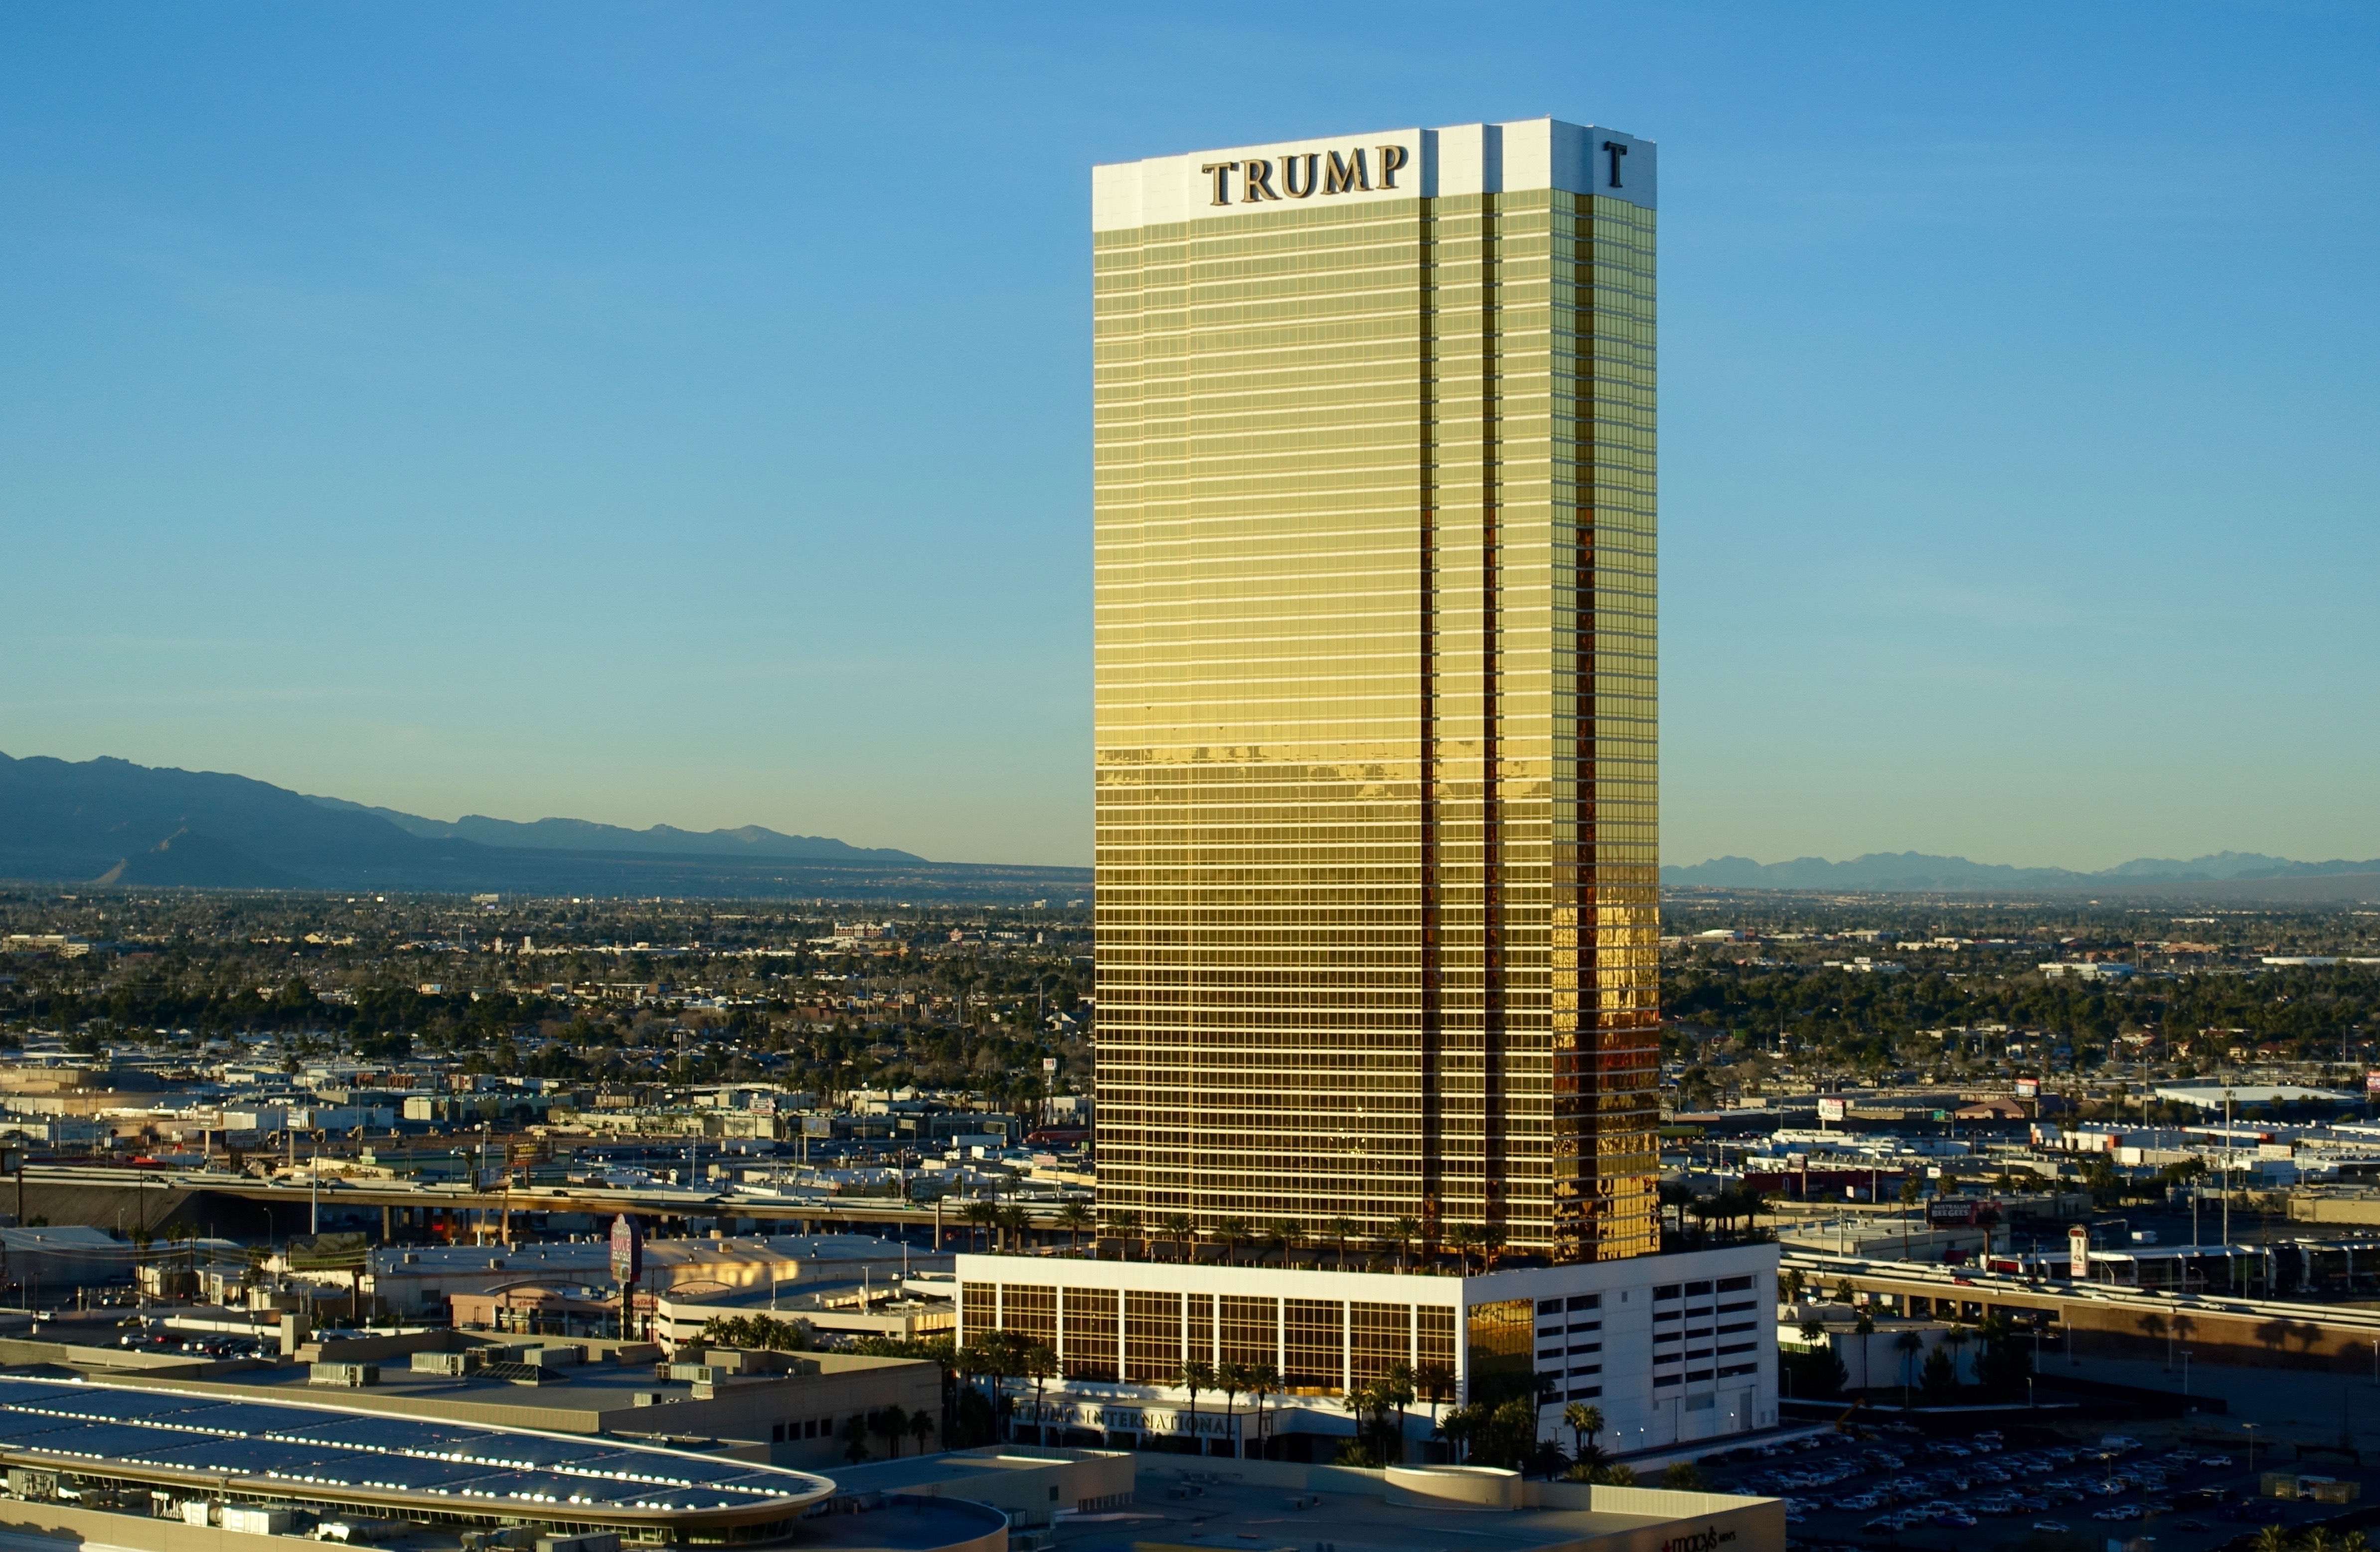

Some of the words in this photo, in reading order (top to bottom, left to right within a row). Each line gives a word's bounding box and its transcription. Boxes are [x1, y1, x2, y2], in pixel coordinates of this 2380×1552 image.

[1201, 144, 1409, 207] TRUMP
[1603, 140, 1628, 188] T
[612, 1234, 630, 1251] LOVE
[1014, 1404, 1075, 1422] TRUMP
[1085, 1409, 1235, 1434] INTERNATIONAL
